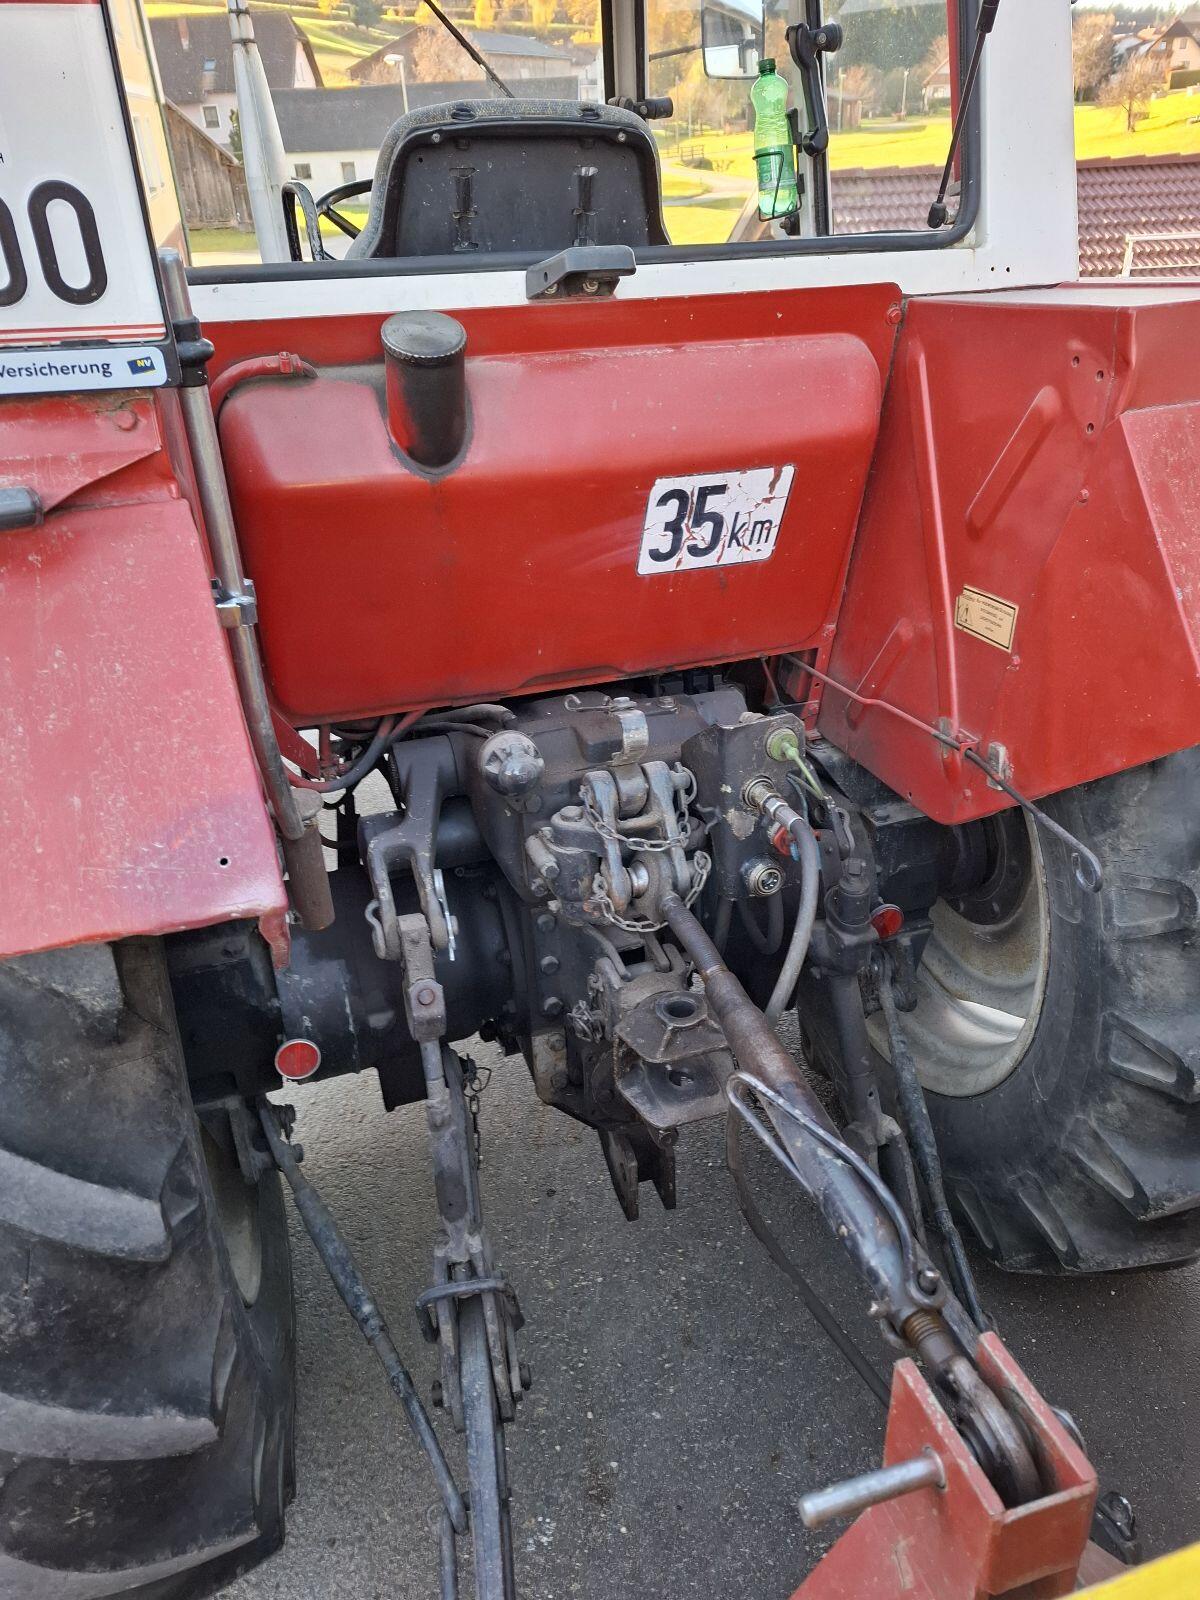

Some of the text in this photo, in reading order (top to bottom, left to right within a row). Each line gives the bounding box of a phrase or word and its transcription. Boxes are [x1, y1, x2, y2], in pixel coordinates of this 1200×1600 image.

[136, 358, 152, 368] NV
[648, 484, 773, 562] 35 km
